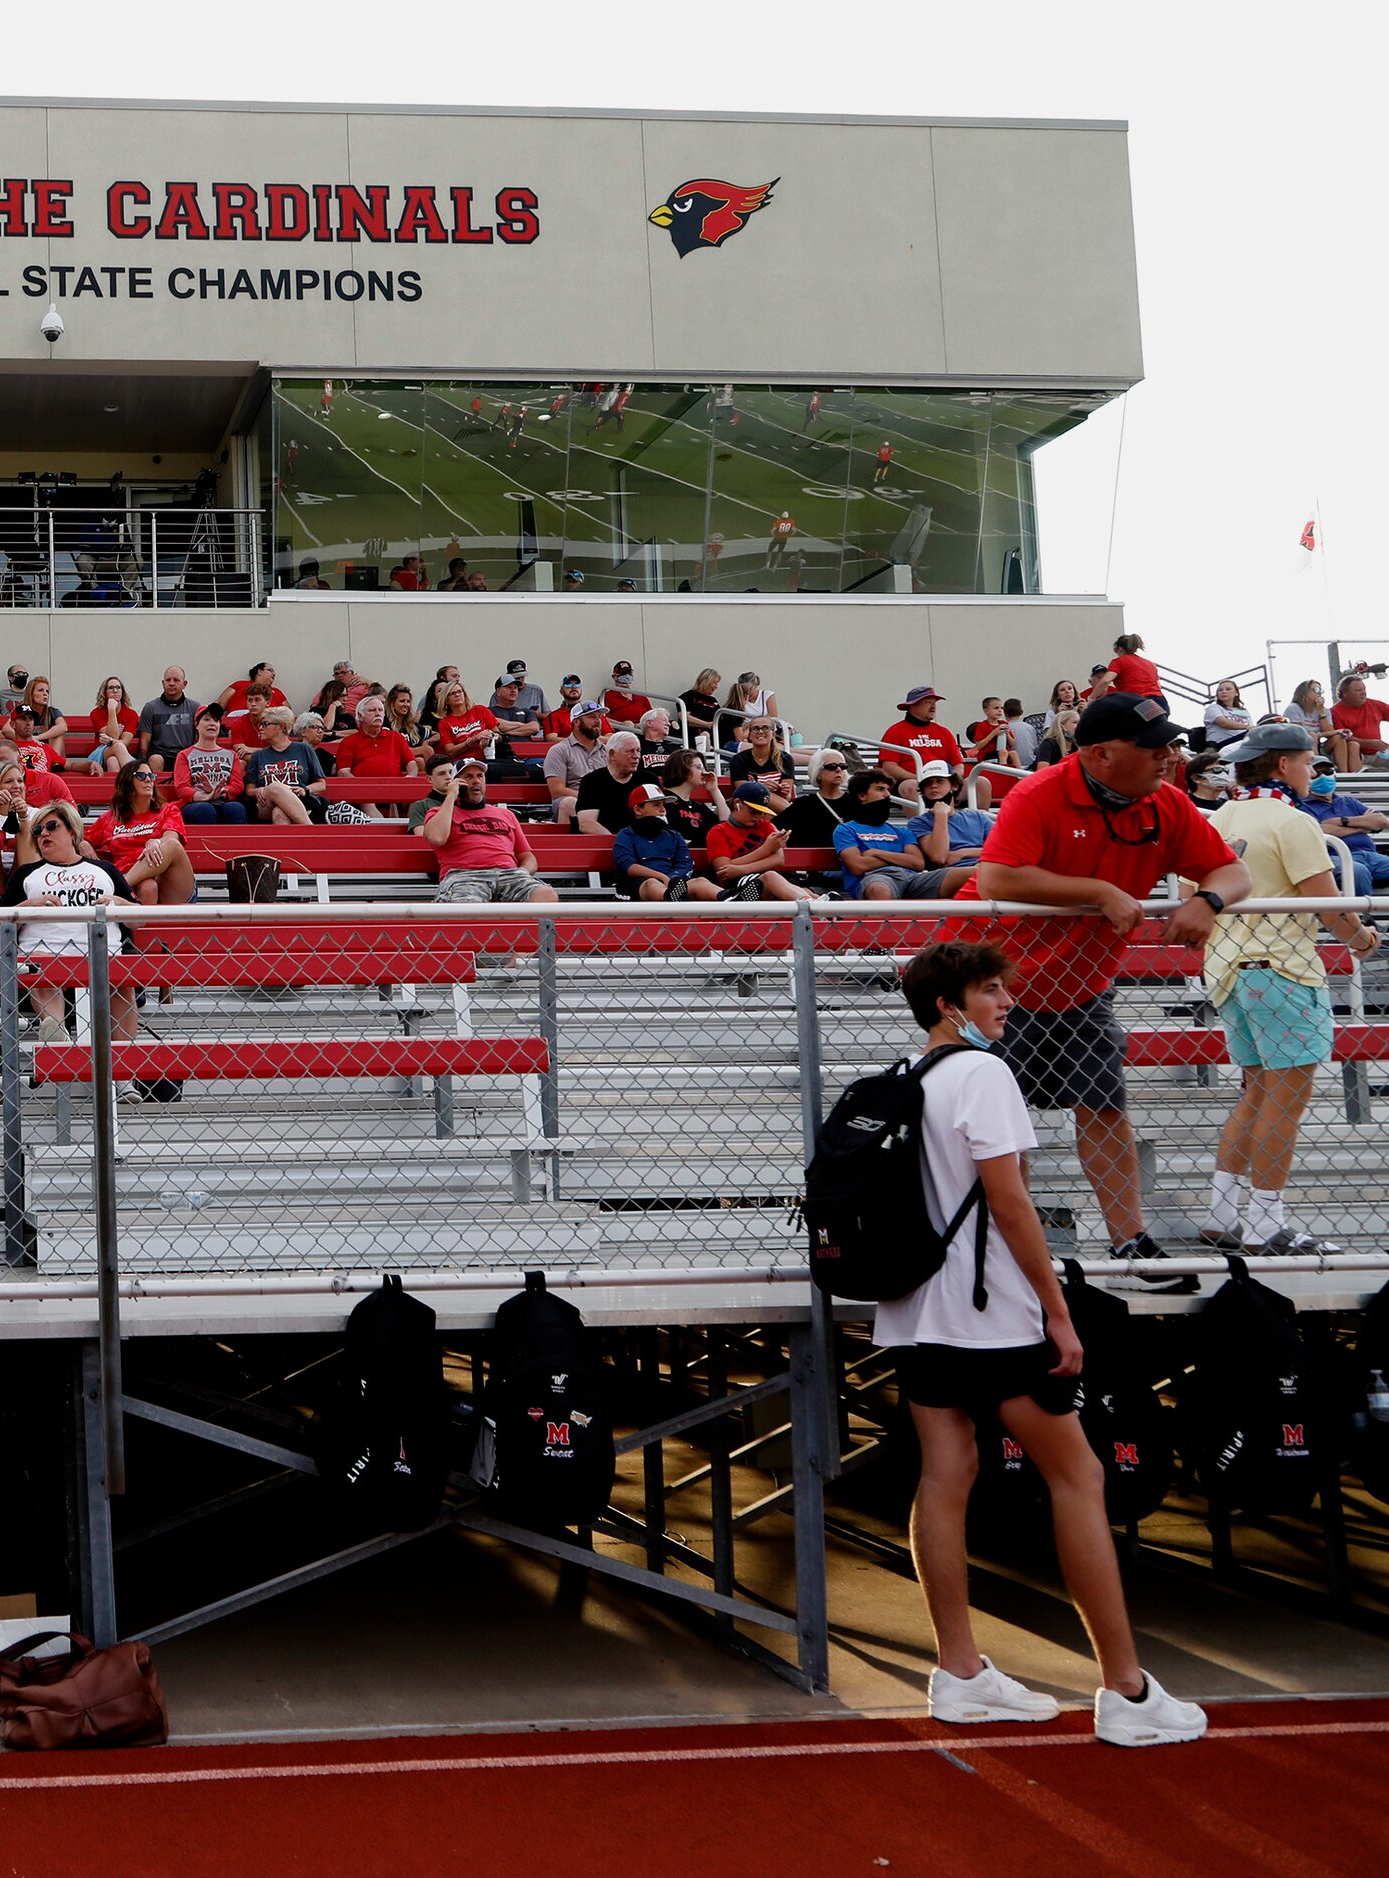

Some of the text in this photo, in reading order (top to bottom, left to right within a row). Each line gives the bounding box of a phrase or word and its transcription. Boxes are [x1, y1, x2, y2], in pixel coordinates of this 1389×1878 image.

[107, 180, 540, 245] CARDINALS
[22, 266, 153, 299] STATE
[168, 268, 423, 303] CHAMPIONS
[44, 869, 96, 891] Classy
[547, 1422, 570, 1445] M
[1282, 1424, 1304, 1446] M
[1114, 1442, 1139, 1464] M
